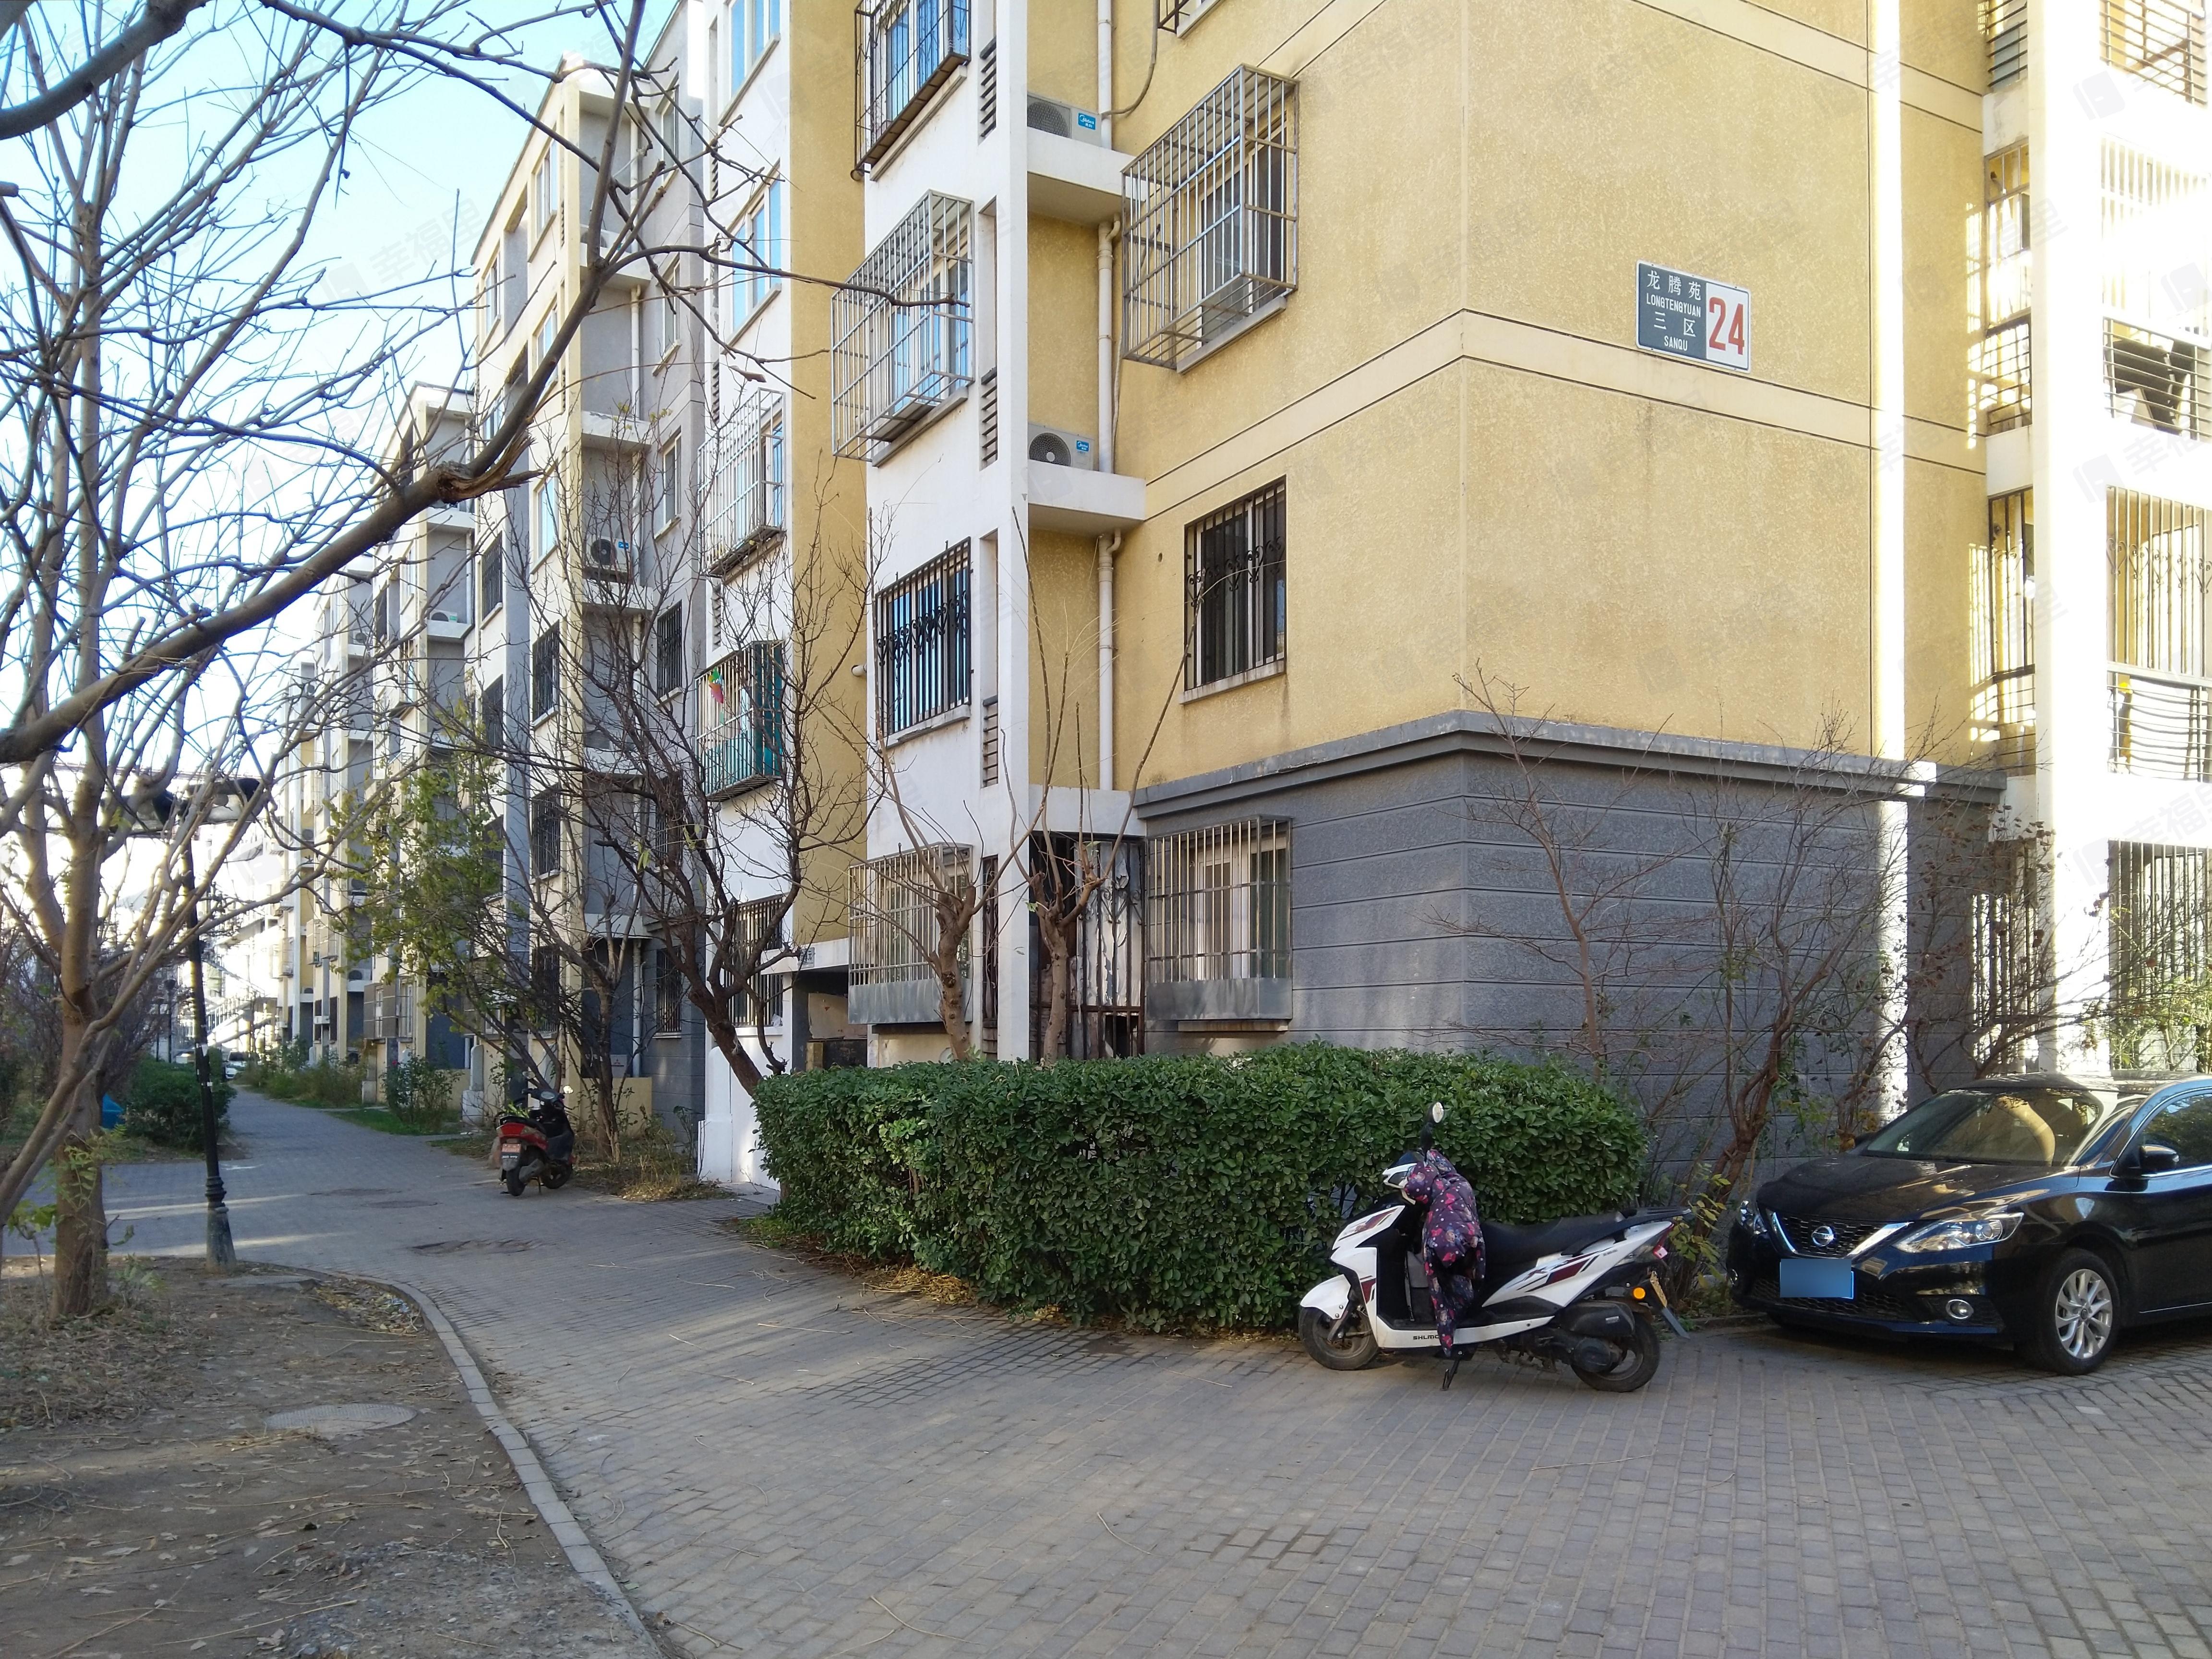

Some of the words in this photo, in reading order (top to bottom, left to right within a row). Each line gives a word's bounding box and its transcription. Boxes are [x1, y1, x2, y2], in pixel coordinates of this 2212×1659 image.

[1647, 270, 1701, 301] 龙腾苑
[1646, 292, 1701, 318] LONGTENGYUAN
[1708, 297, 1745, 355] 24
[1664, 335, 1688, 351] SANQU
